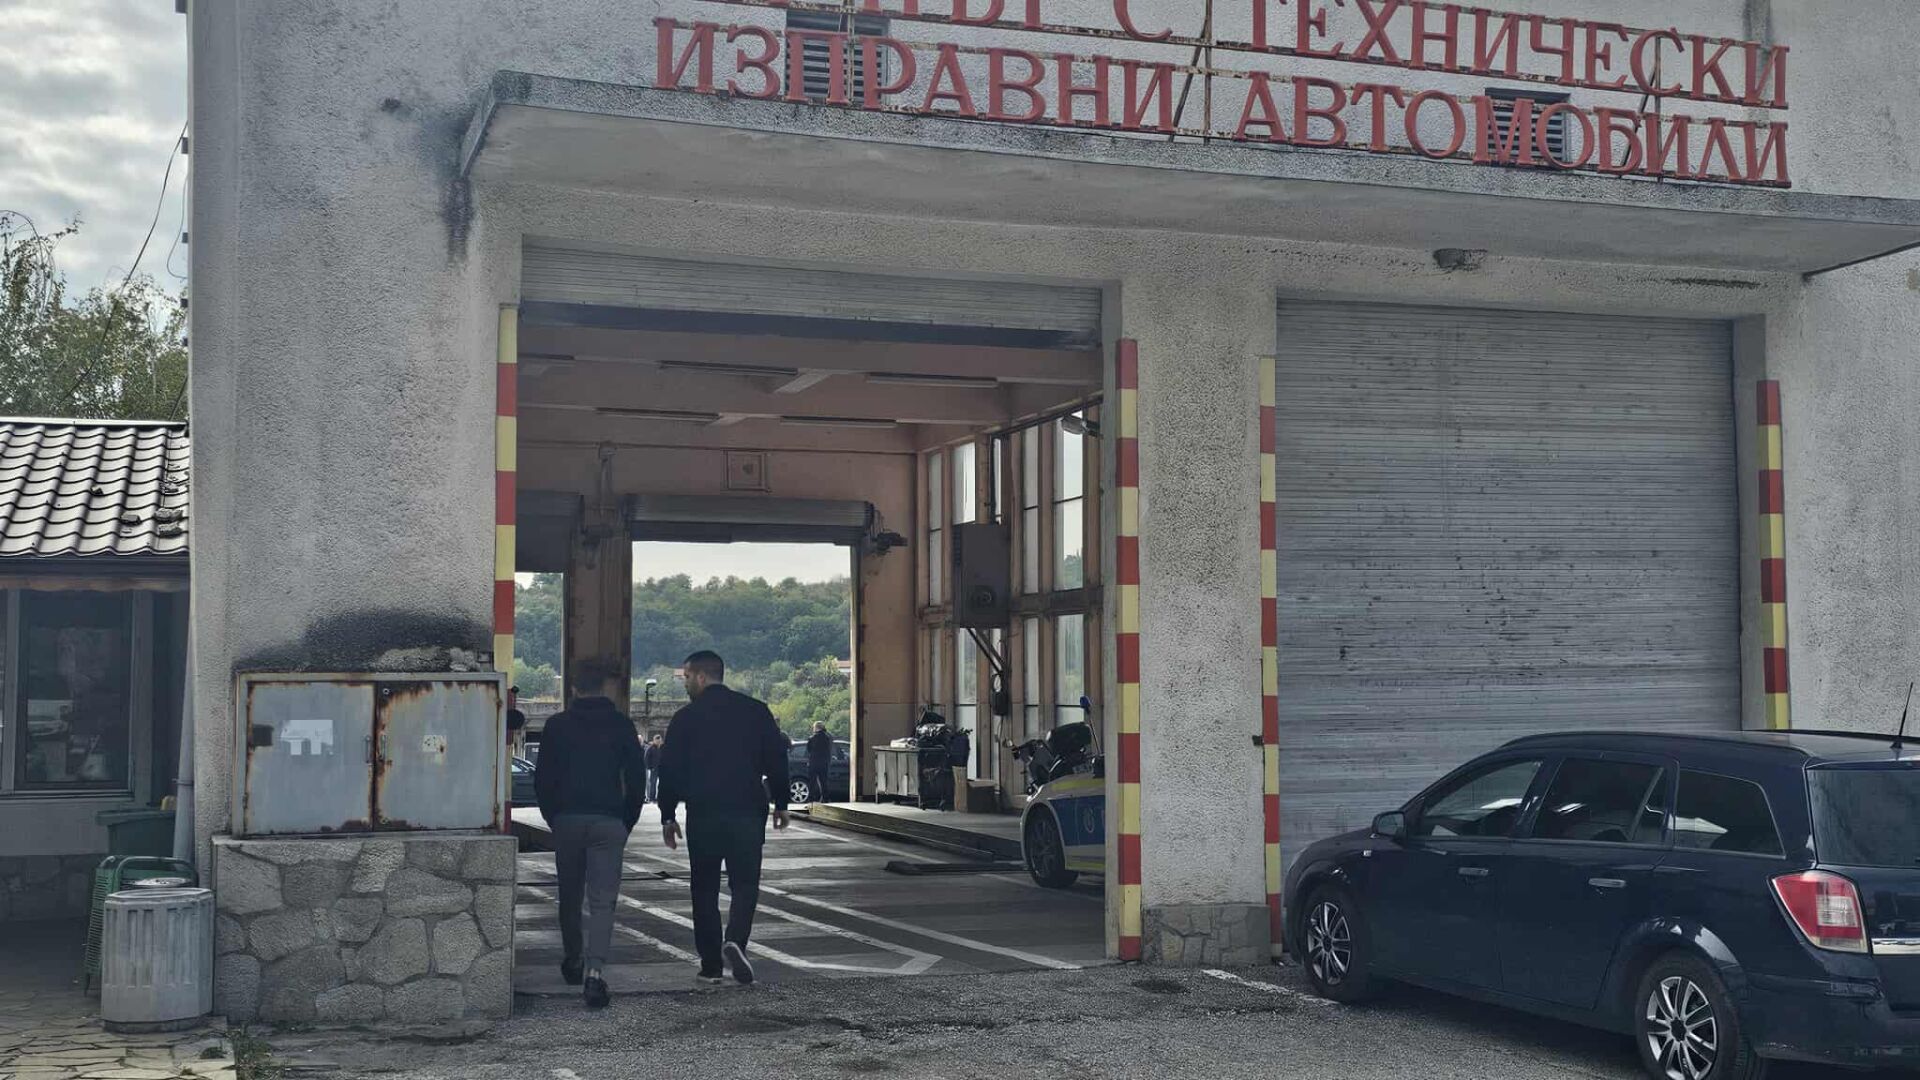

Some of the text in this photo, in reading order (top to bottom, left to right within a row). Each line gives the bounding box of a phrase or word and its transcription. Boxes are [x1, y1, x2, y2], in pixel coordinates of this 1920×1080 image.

[653, 17, 1791, 188] ИЗПРАВНИ АВТОМОБИЛИ
[1250, 0, 1791, 109] ТЕХНИЧЕСКИ
